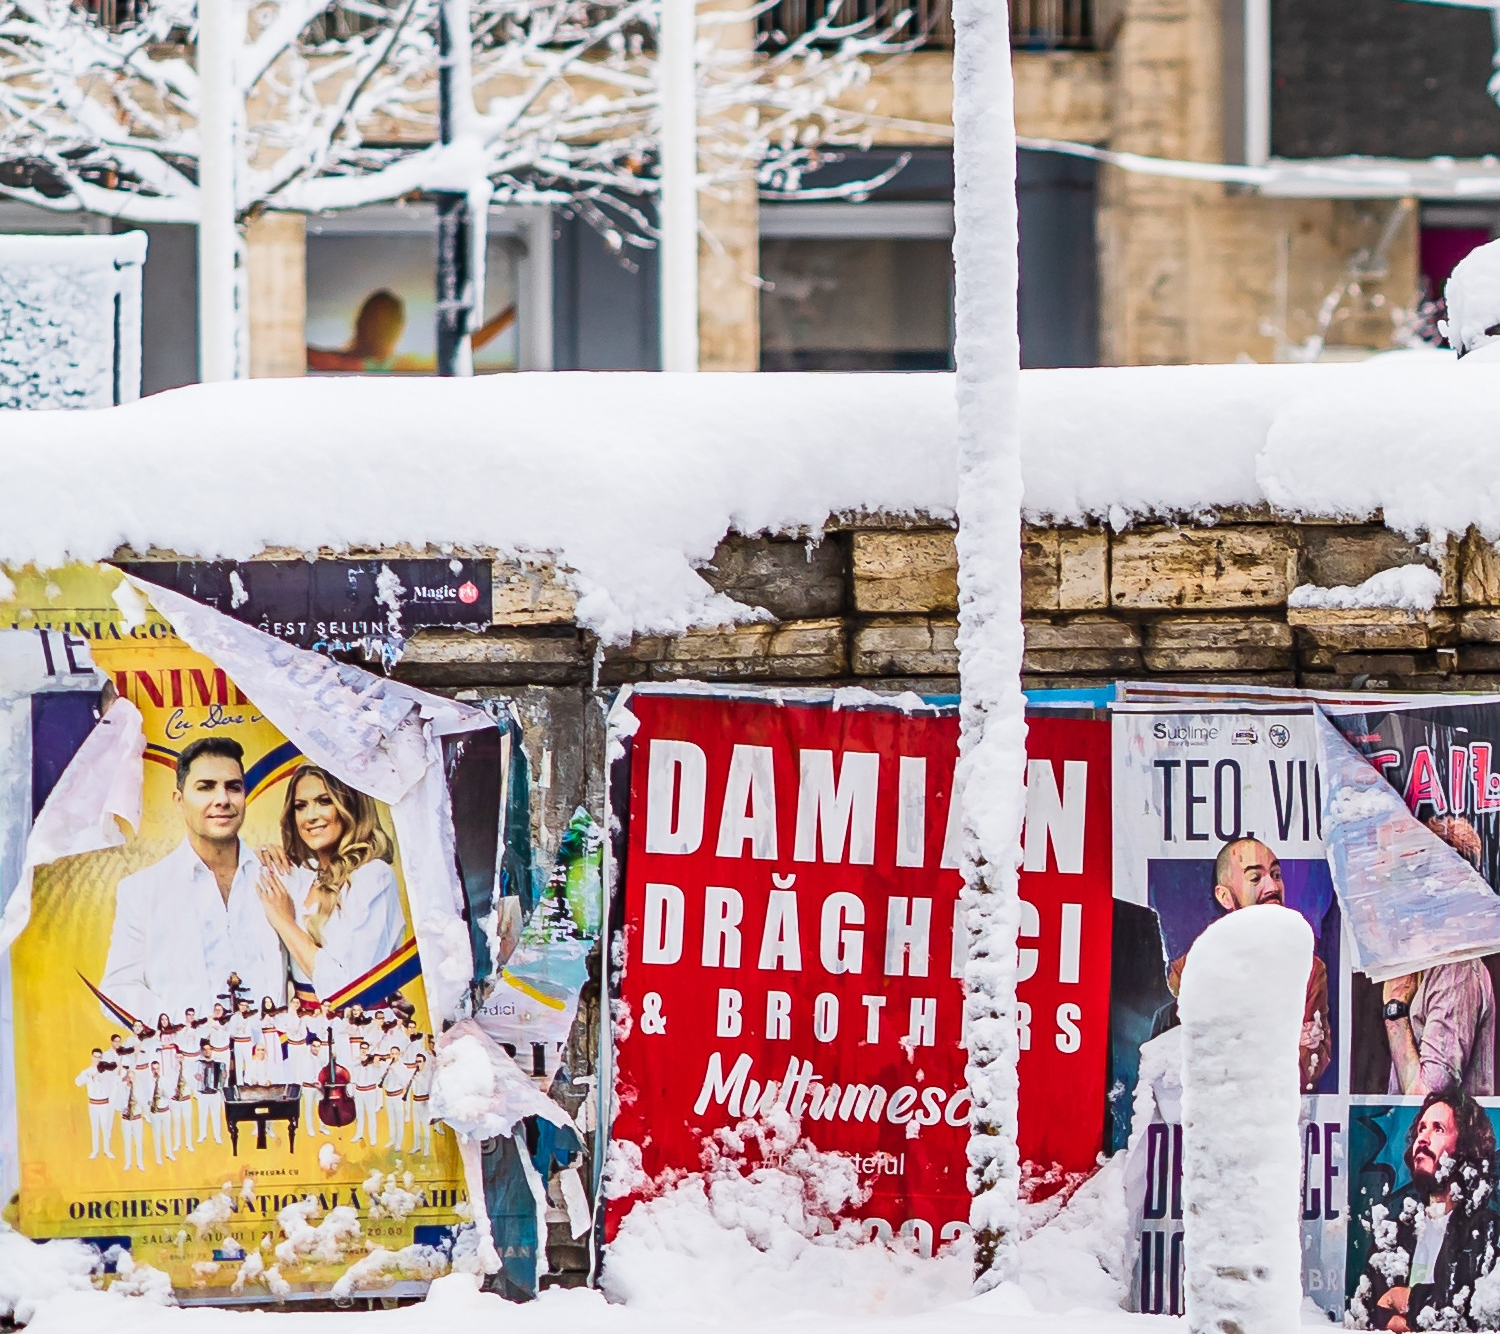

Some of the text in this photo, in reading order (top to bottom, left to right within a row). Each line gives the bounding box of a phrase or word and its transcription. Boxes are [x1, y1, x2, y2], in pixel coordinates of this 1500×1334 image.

[414, 584, 457, 600] Magic
[641, 988, 1082, 1054] & BROTHRS
[69, 1198, 200, 1220] ORCHESTR
